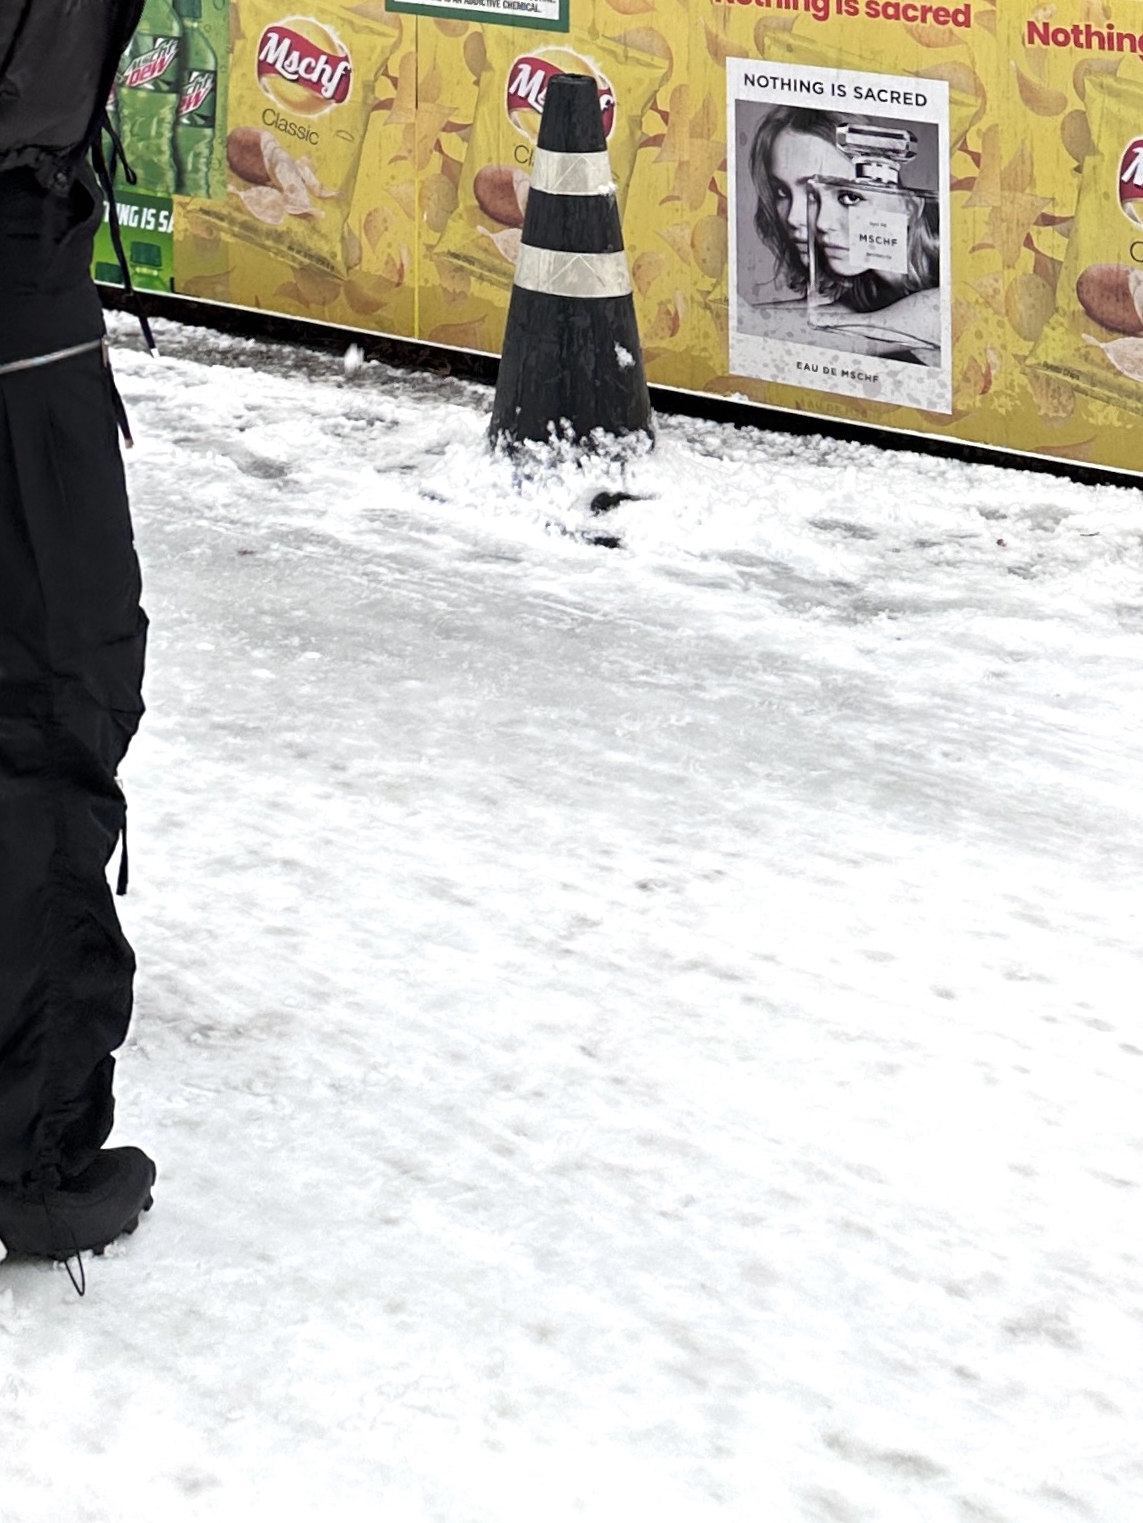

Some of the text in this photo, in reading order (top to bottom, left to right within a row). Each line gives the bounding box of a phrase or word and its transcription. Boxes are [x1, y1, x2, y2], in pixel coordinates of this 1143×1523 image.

[259, 32, 352, 100] Mschf
[743, 72, 928, 109] NOTHING IS SACRED
[261, 108, 321, 146] Classic
[140, 207, 157, 231] IS
[859, 233, 898, 247] MSCHF
[796, 361, 879, 383] EAU DE MSCHF
